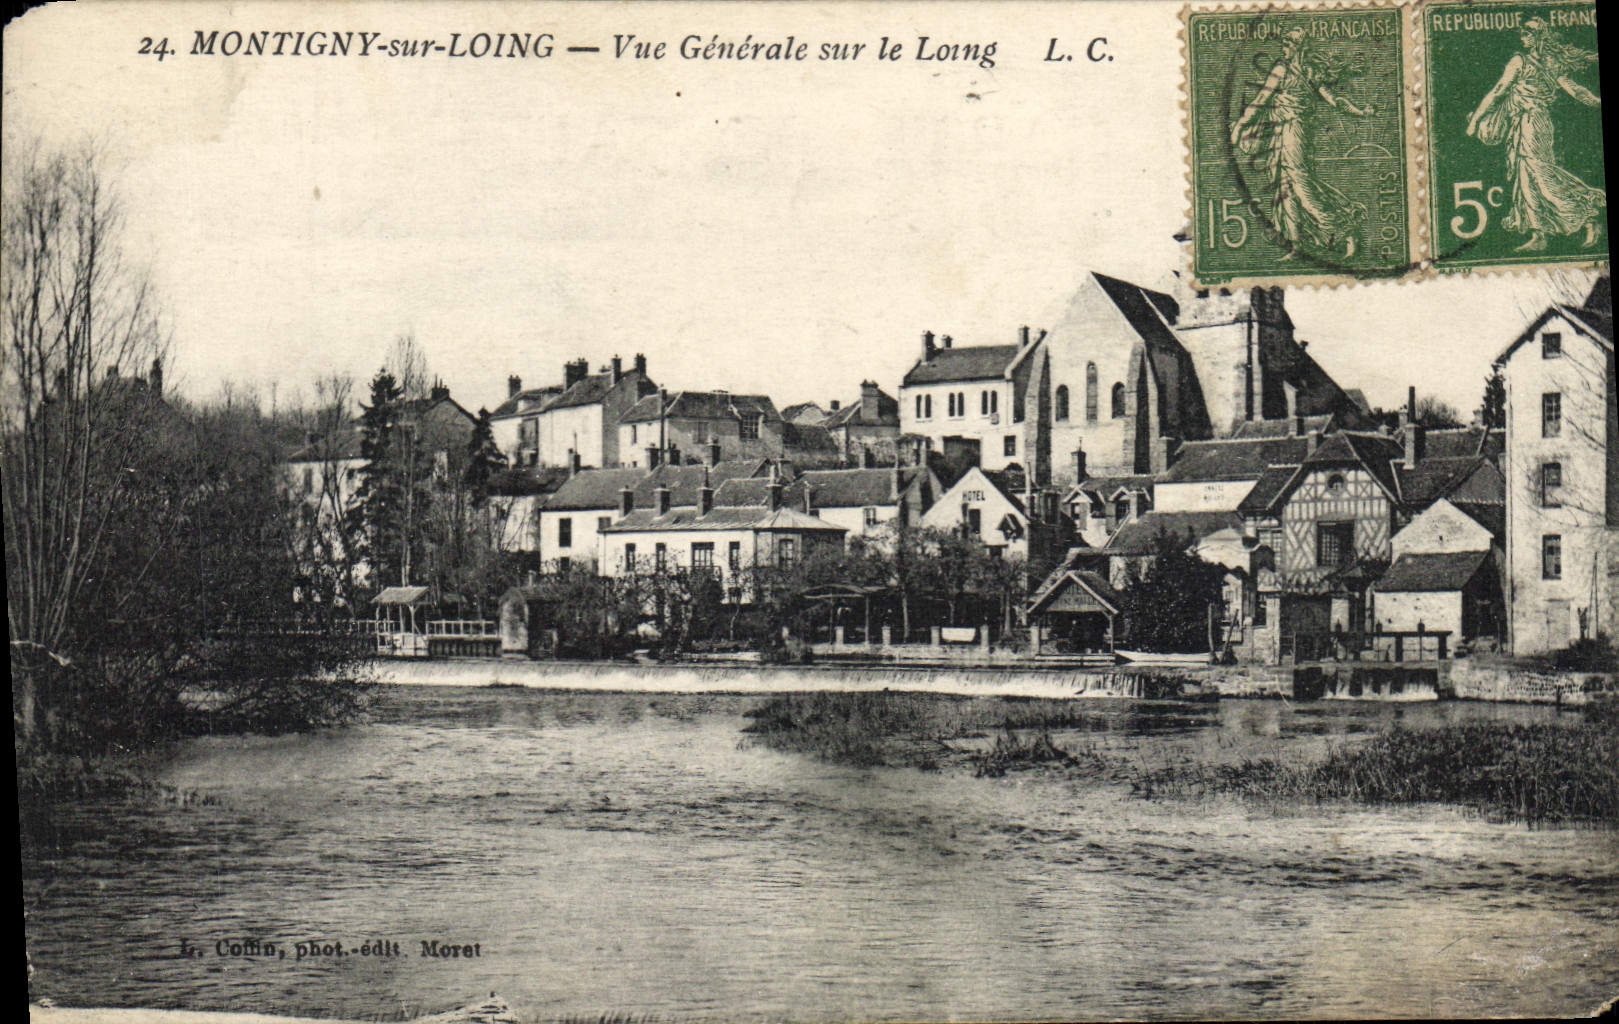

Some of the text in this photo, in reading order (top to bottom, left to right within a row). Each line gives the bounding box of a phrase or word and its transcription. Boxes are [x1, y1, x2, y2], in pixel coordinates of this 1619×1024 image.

[1433, 12, 1523, 32] REPUBLIQUE
[1379, 170, 1399, 260] POSTES
[962, 490, 986, 501] HOTEL
